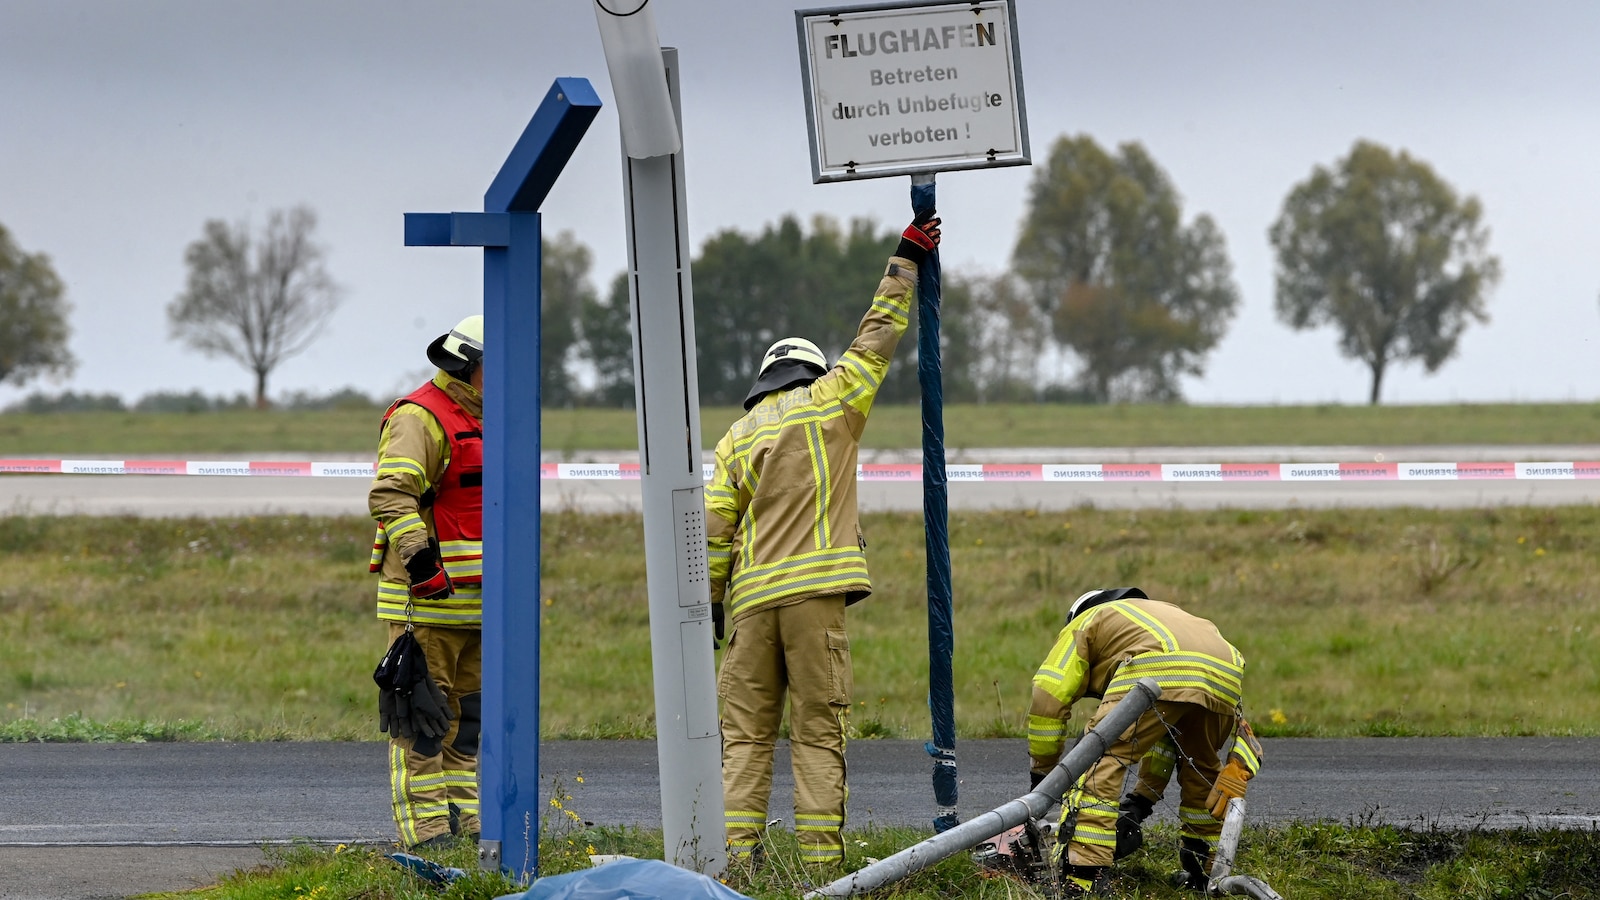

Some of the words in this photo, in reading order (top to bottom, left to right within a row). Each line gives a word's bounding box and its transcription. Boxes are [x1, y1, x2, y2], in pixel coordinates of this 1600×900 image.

[824, 21, 997, 60] FLUGHAFEN
[870, 65, 958, 86] Betreten
[831, 99, 890, 120] durch
[897, 92, 1003, 115] Unbefugte
[868, 124, 958, 147] verboten
[965, 122, 971, 139] !
